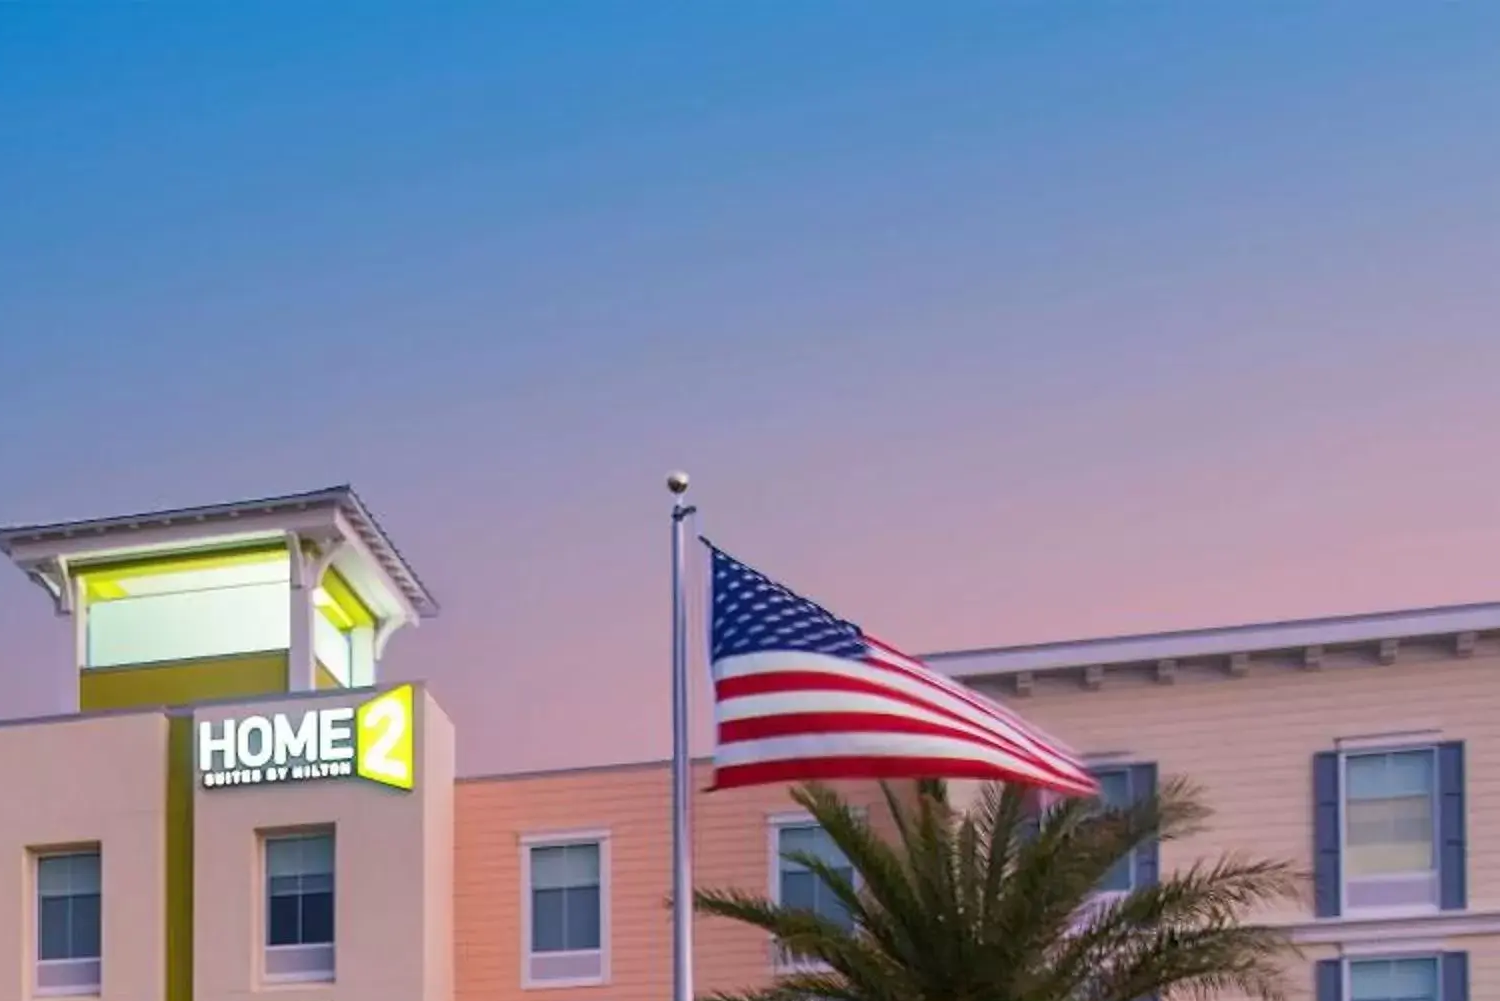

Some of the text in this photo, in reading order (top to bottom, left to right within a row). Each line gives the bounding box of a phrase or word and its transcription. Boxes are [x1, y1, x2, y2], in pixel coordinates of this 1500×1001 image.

[200, 696, 408, 781] HOME 2
[204, 761, 350, 787] SUITES BY HILTON
